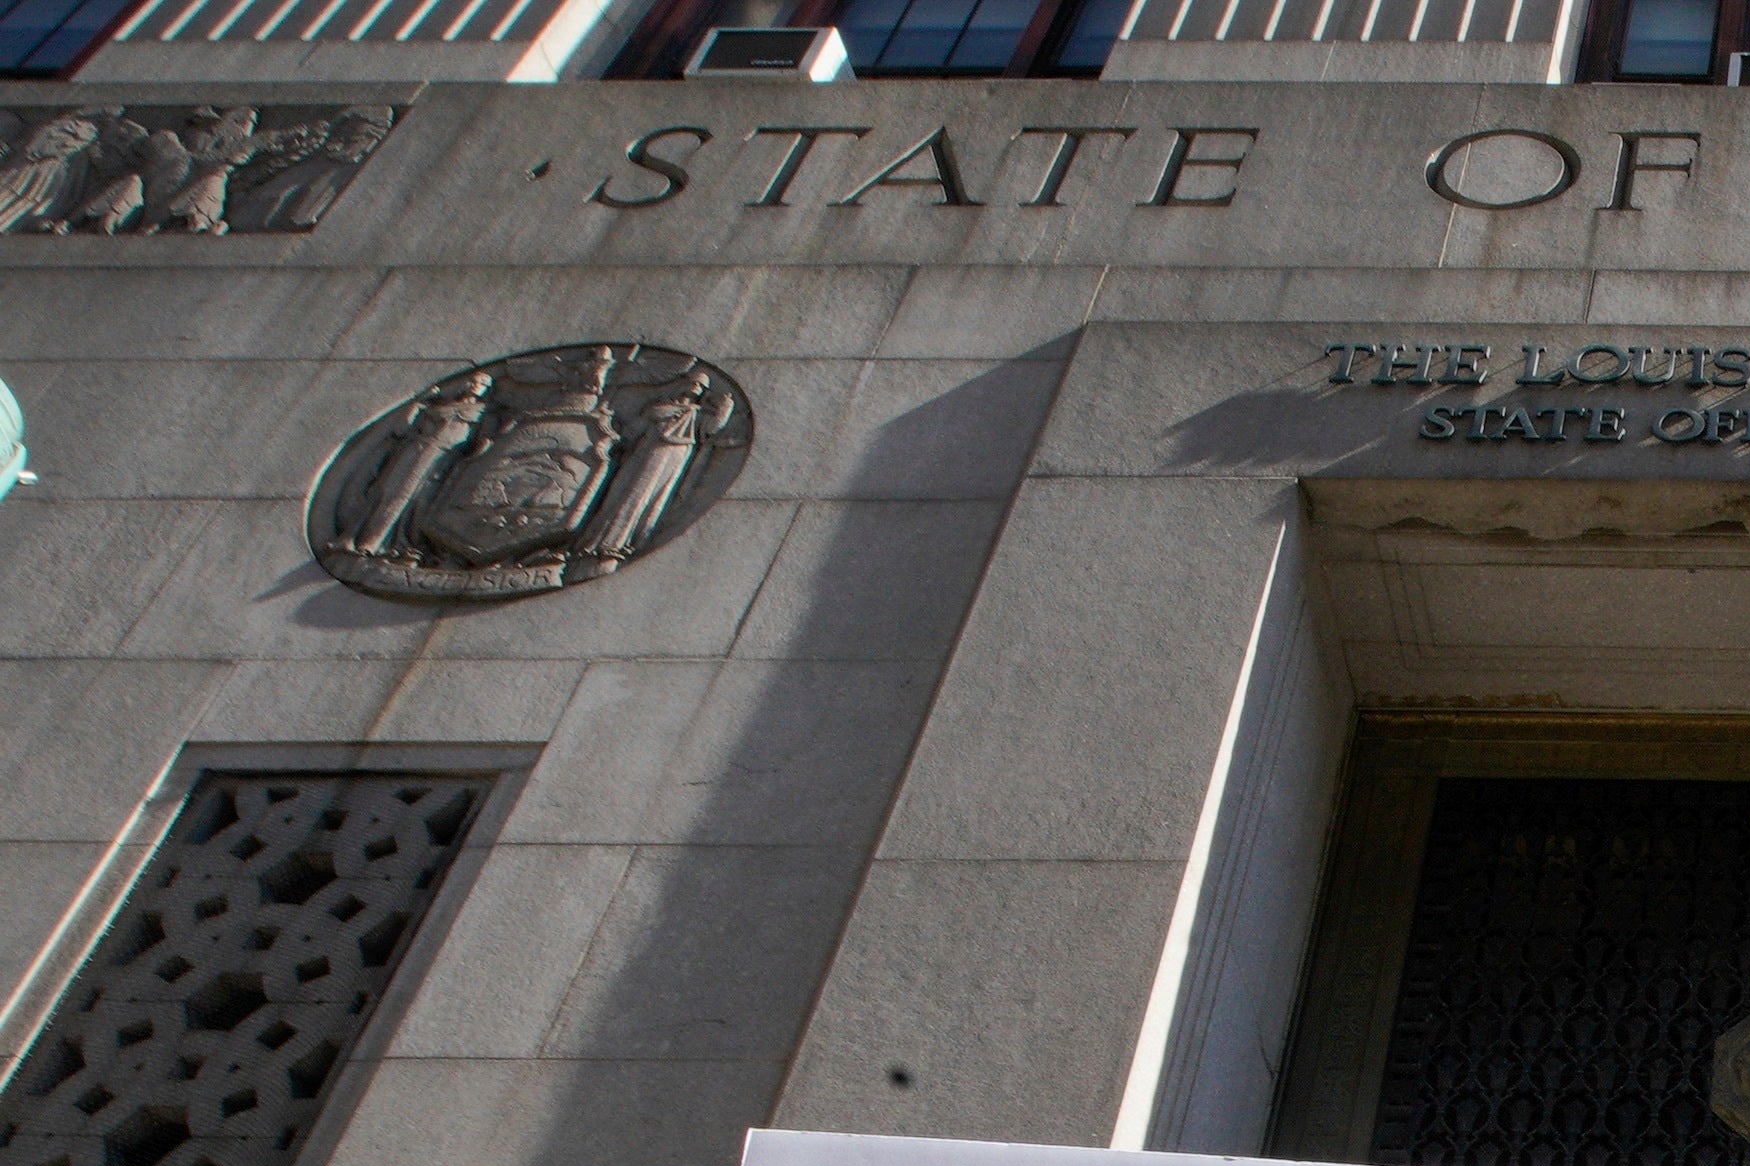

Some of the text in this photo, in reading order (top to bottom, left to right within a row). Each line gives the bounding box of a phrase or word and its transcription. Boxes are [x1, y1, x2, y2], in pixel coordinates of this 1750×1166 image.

[585, 124, 1260, 209] STATE
[1424, 127, 1702, 212] OF
[1325, 341, 1491, 385] THE
[1418, 404, 1627, 442] STATE
